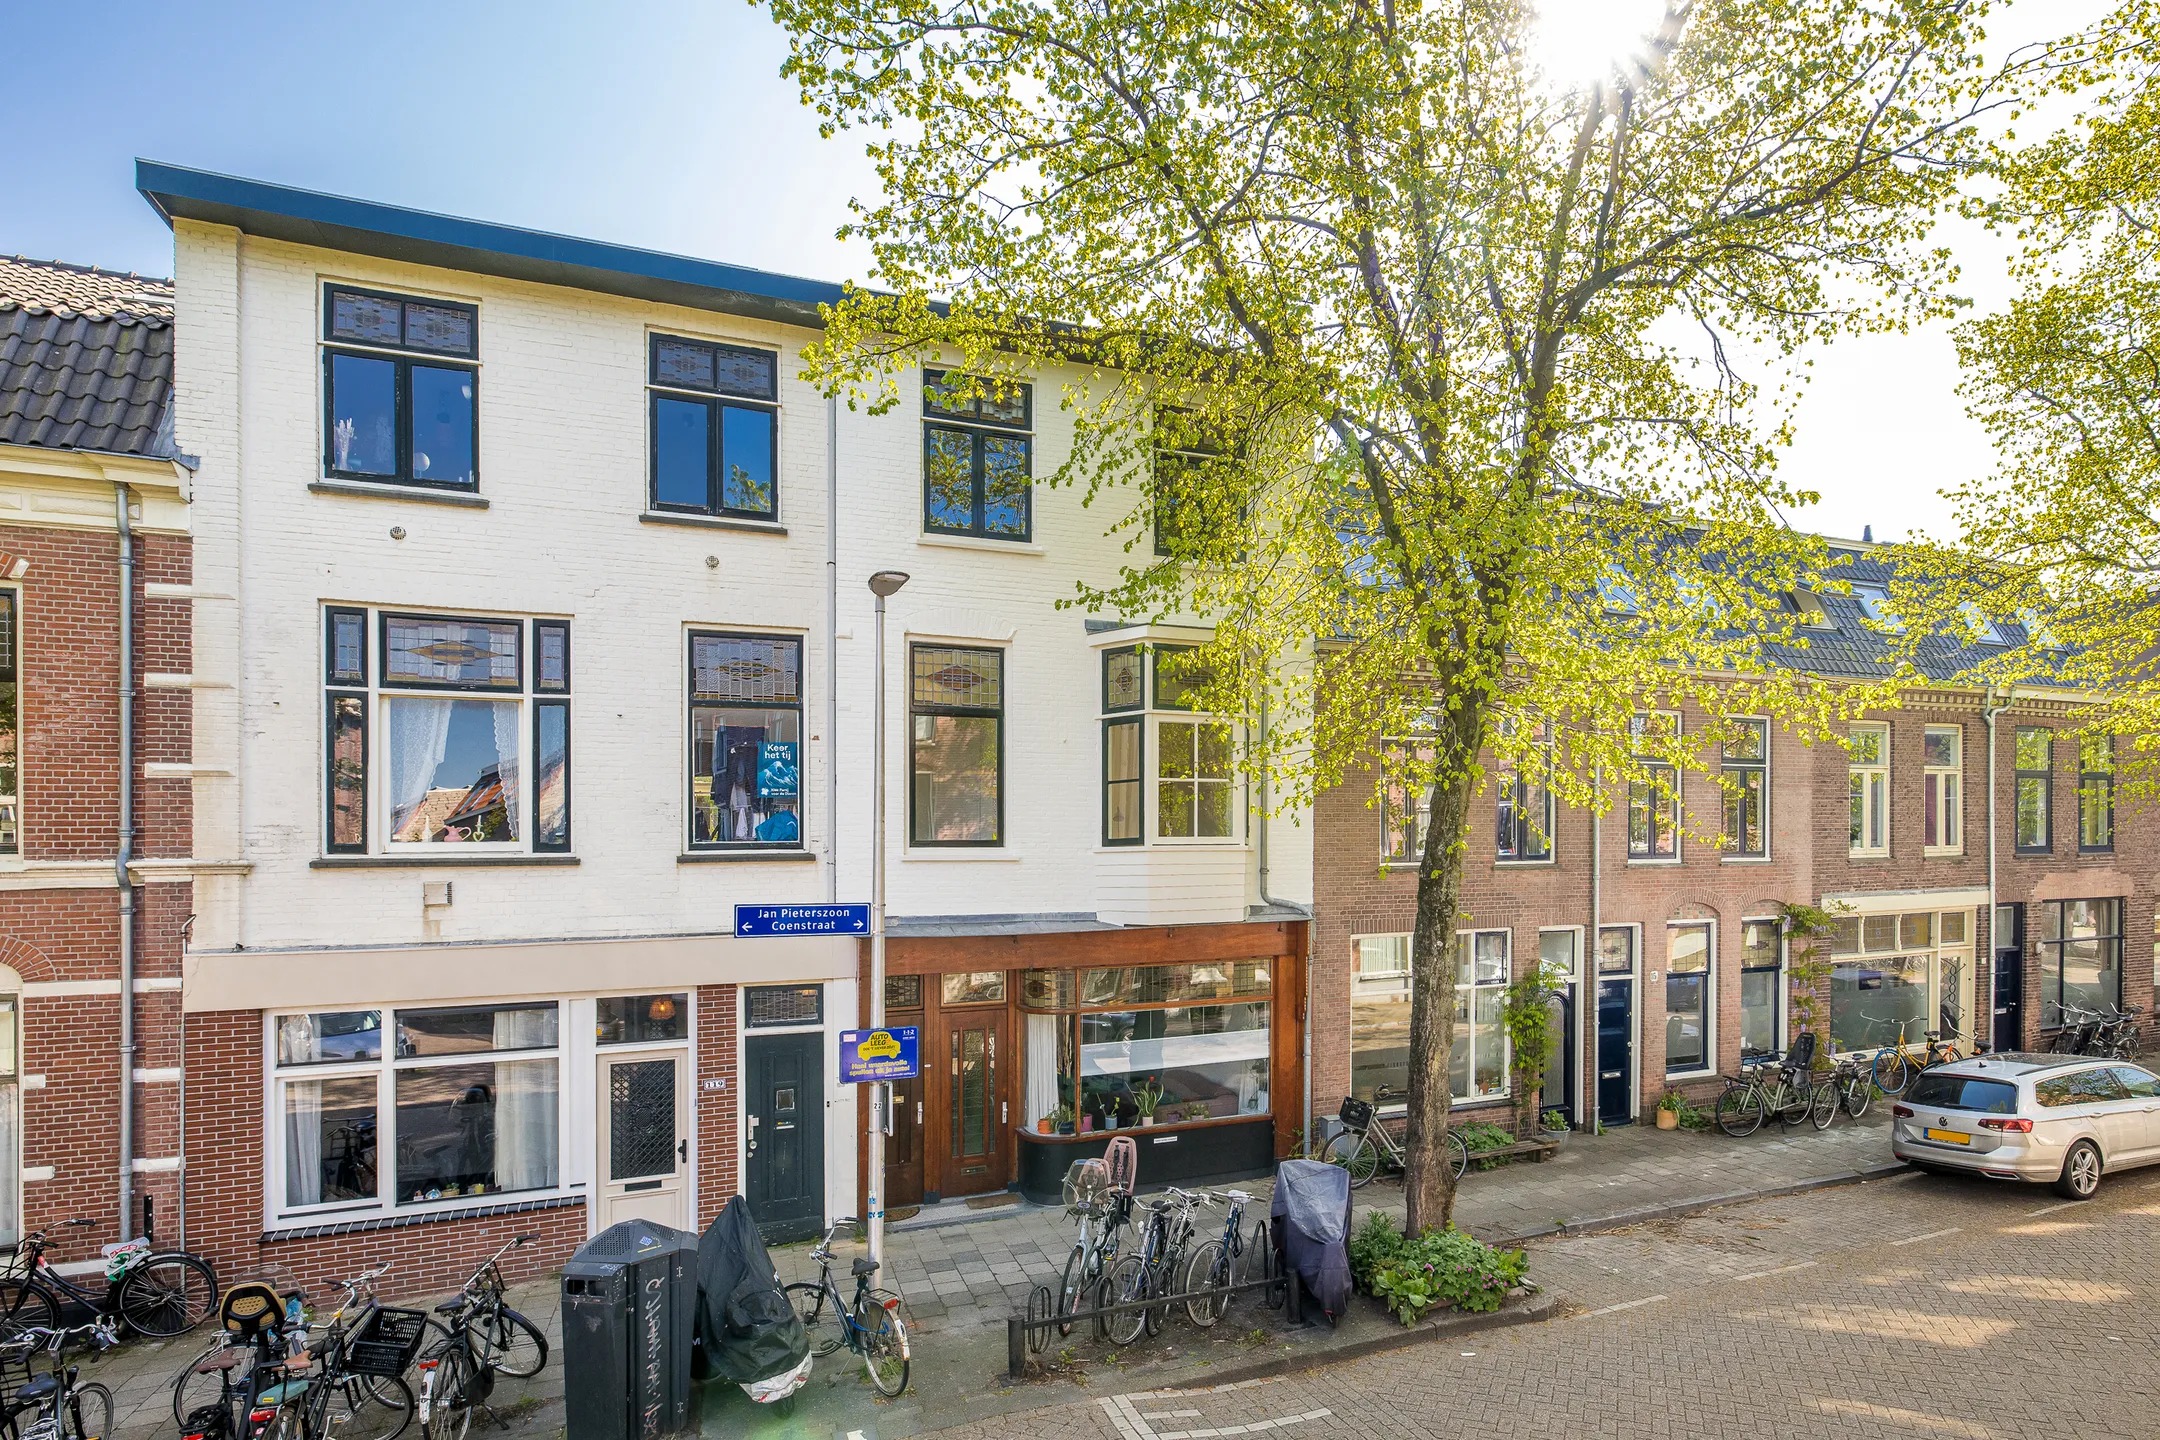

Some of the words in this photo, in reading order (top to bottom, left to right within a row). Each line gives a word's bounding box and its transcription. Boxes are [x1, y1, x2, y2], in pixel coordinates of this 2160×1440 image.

[764, 751, 779, 759] het
[781, 751, 791, 760] tij
[758, 909, 777, 919] Jan
[781, 908, 850, 918] Pieterszoon
[771, 921, 836, 931] Coenstraat
